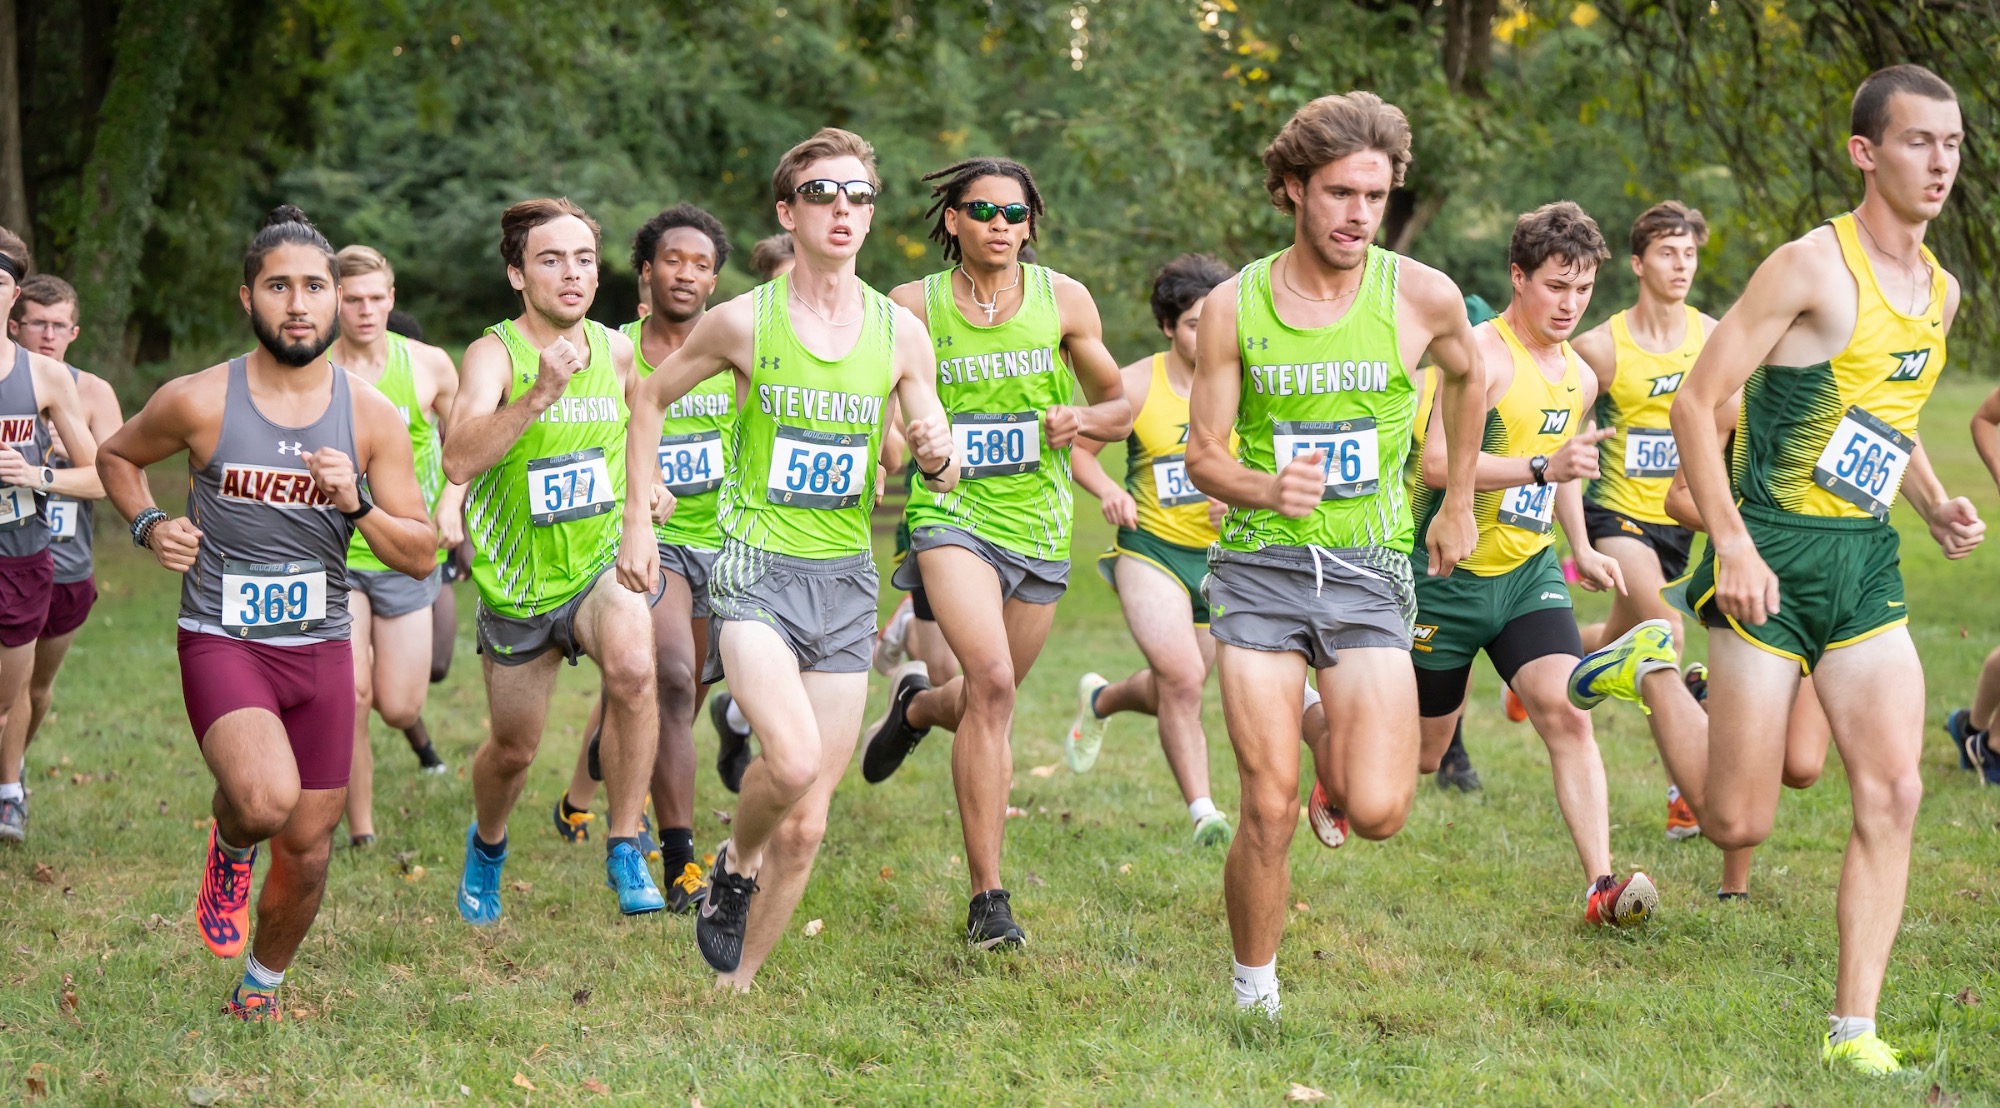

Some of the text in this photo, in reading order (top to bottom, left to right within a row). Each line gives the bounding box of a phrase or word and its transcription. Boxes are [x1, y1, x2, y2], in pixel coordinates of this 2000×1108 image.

[940, 346, 1055, 385] STEVENSON
[1249, 360, 1388, 396] STEVENSON
[1887, 349, 1929, 380] M
[666, 392, 729, 419] ENSON
[758, 383, 884, 425] STEVENSON
[973, 413, 1002, 421] GOUCHER
[1540, 409, 1569, 433] M
[802, 429, 836, 441] GOUCHER
[1299, 421, 1334, 430] GOUCHER
[966, 428, 1024, 466] 580
[1836, 432, 1897, 496] 565
[658, 447, 711, 484] 584
[786, 447, 853, 494] 583
[544, 466, 595, 511] 577
[1515, 482, 1552, 518] 54
[249, 563, 283, 572] GOUCHER
[240, 581, 308, 625] 369
